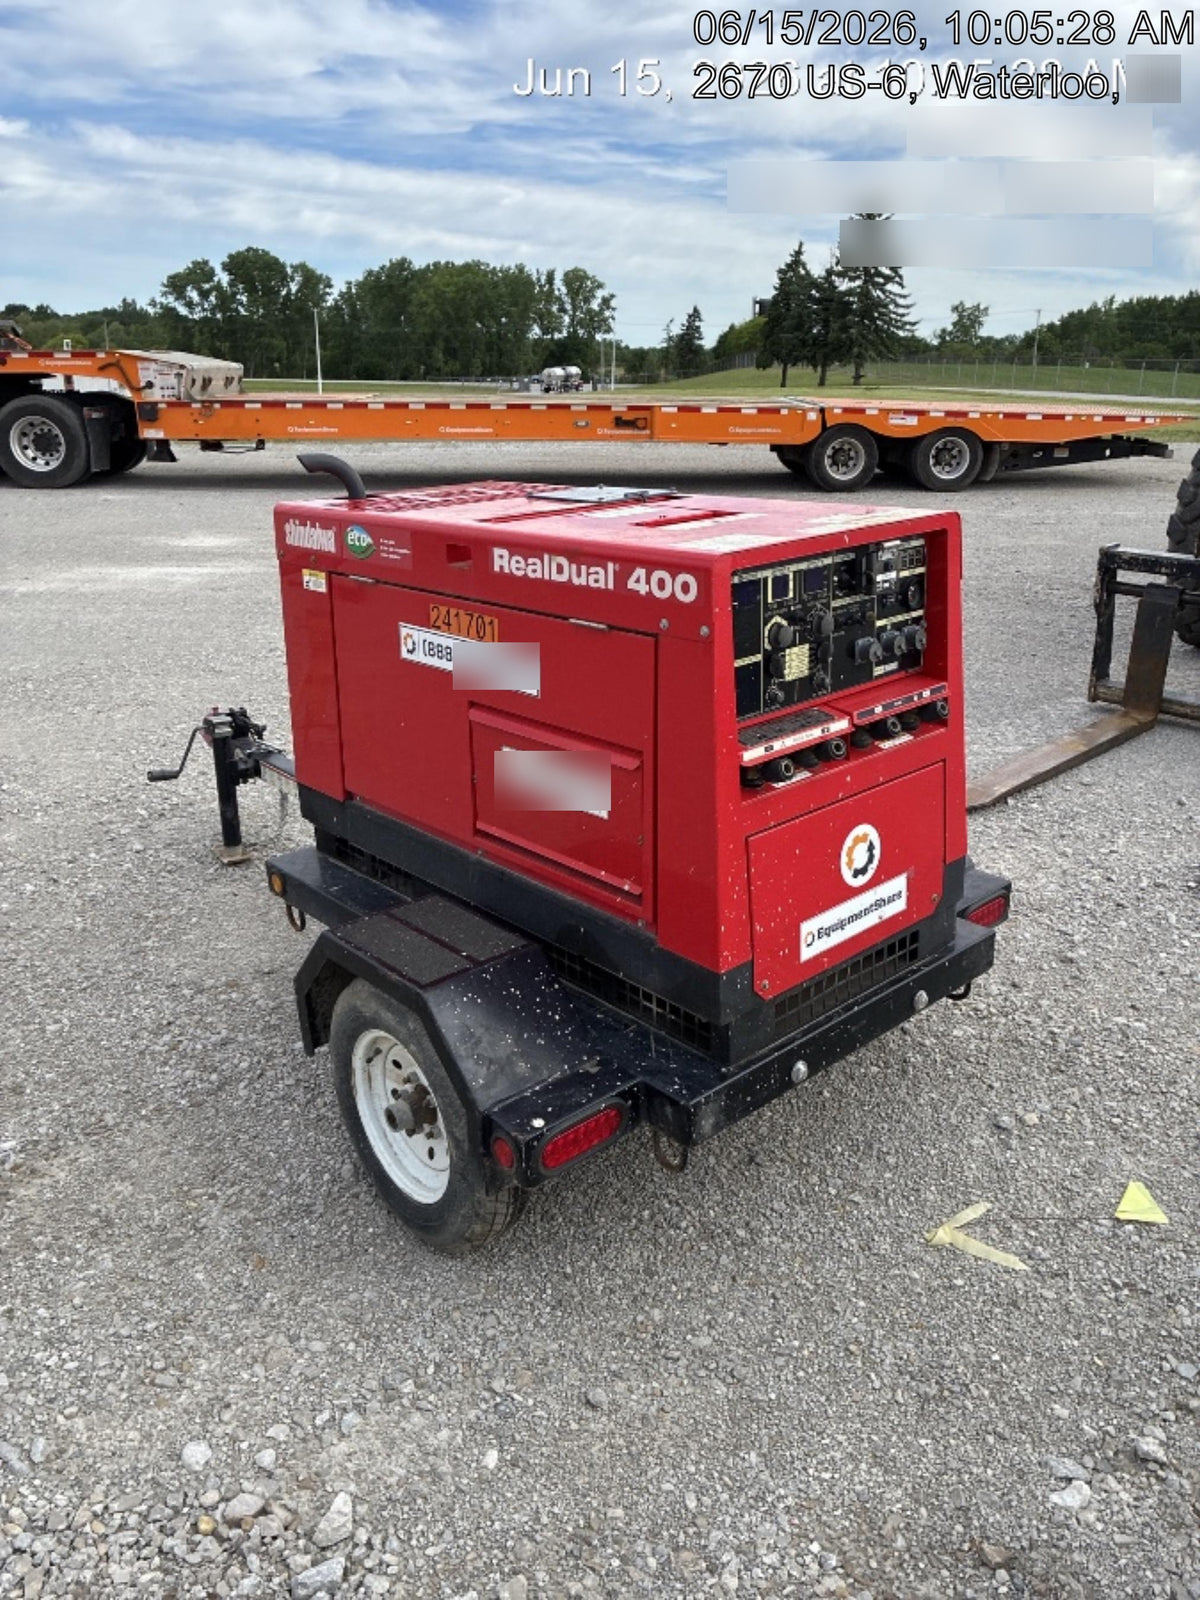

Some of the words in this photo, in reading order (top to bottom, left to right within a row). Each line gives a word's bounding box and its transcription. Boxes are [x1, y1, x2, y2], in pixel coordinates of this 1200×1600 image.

[492, 547, 614, 590] RealDual
[627, 568, 698, 603] 400
[431, 605, 496, 642] 241701
[422, 639, 453, 662] (888
[816, 889, 903, 940] EquipmentShare
